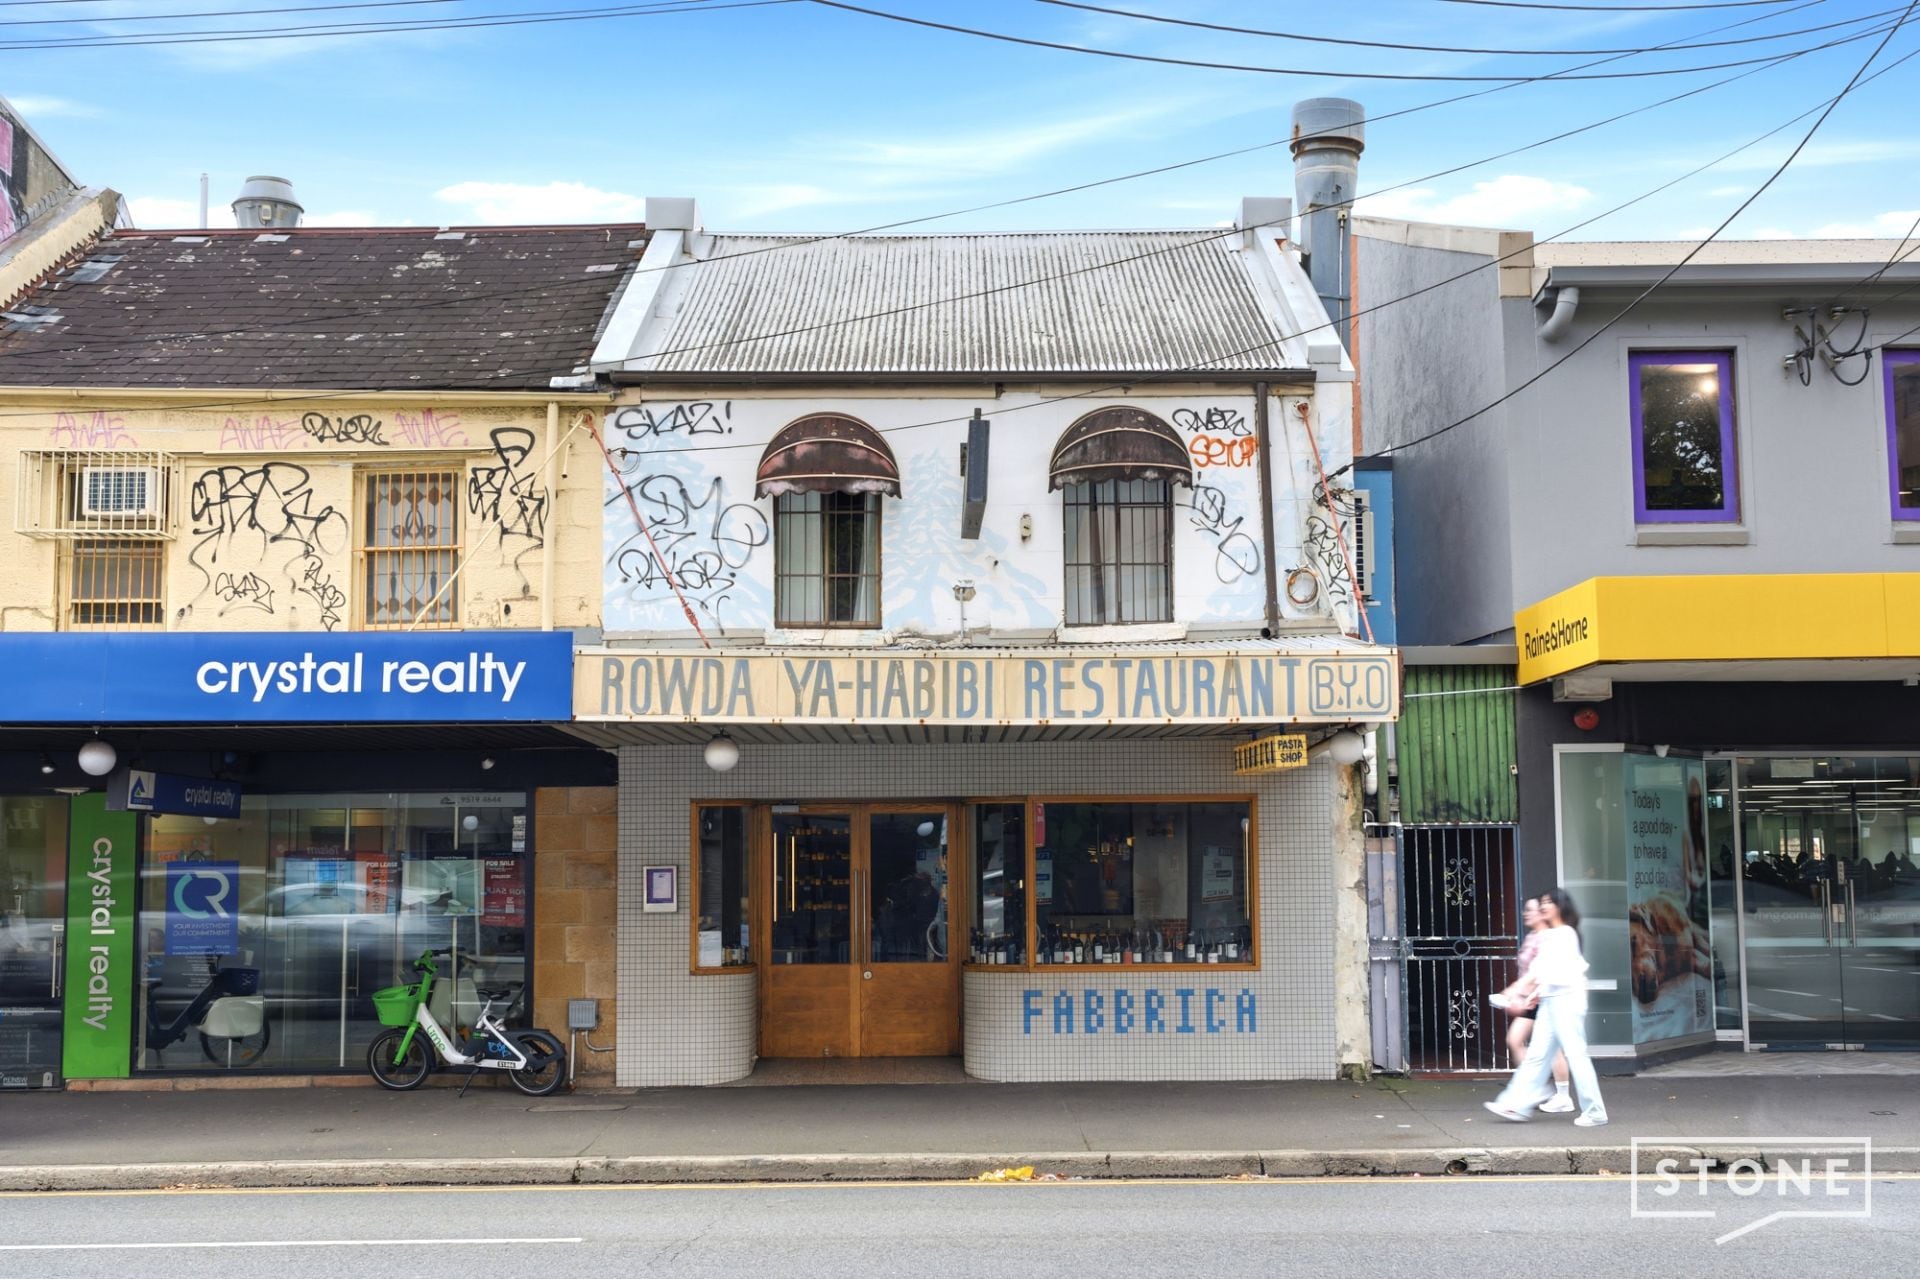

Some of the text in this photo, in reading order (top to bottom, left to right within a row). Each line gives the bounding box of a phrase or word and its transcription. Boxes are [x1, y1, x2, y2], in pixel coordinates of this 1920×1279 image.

[1525, 617, 1588, 661] Raine&Horne
[196, 652, 526, 702] crystal realty
[602, 658, 1301, 718] ROWDA YA-HABIBI RESTAURANT
[1278, 739, 1303, 750] PASTA
[1280, 752, 1303, 763] SHOP
[185, 785, 235, 809] crystal realty
[1632, 790, 1661, 812] Today's
[1640, 818, 1658, 838] good
[1634, 844, 1642, 860] to
[1643, 842, 1661, 860] have
[82, 837, 116, 1031] crystal realty
[1023, 988, 1256, 1034] FABBRICA
